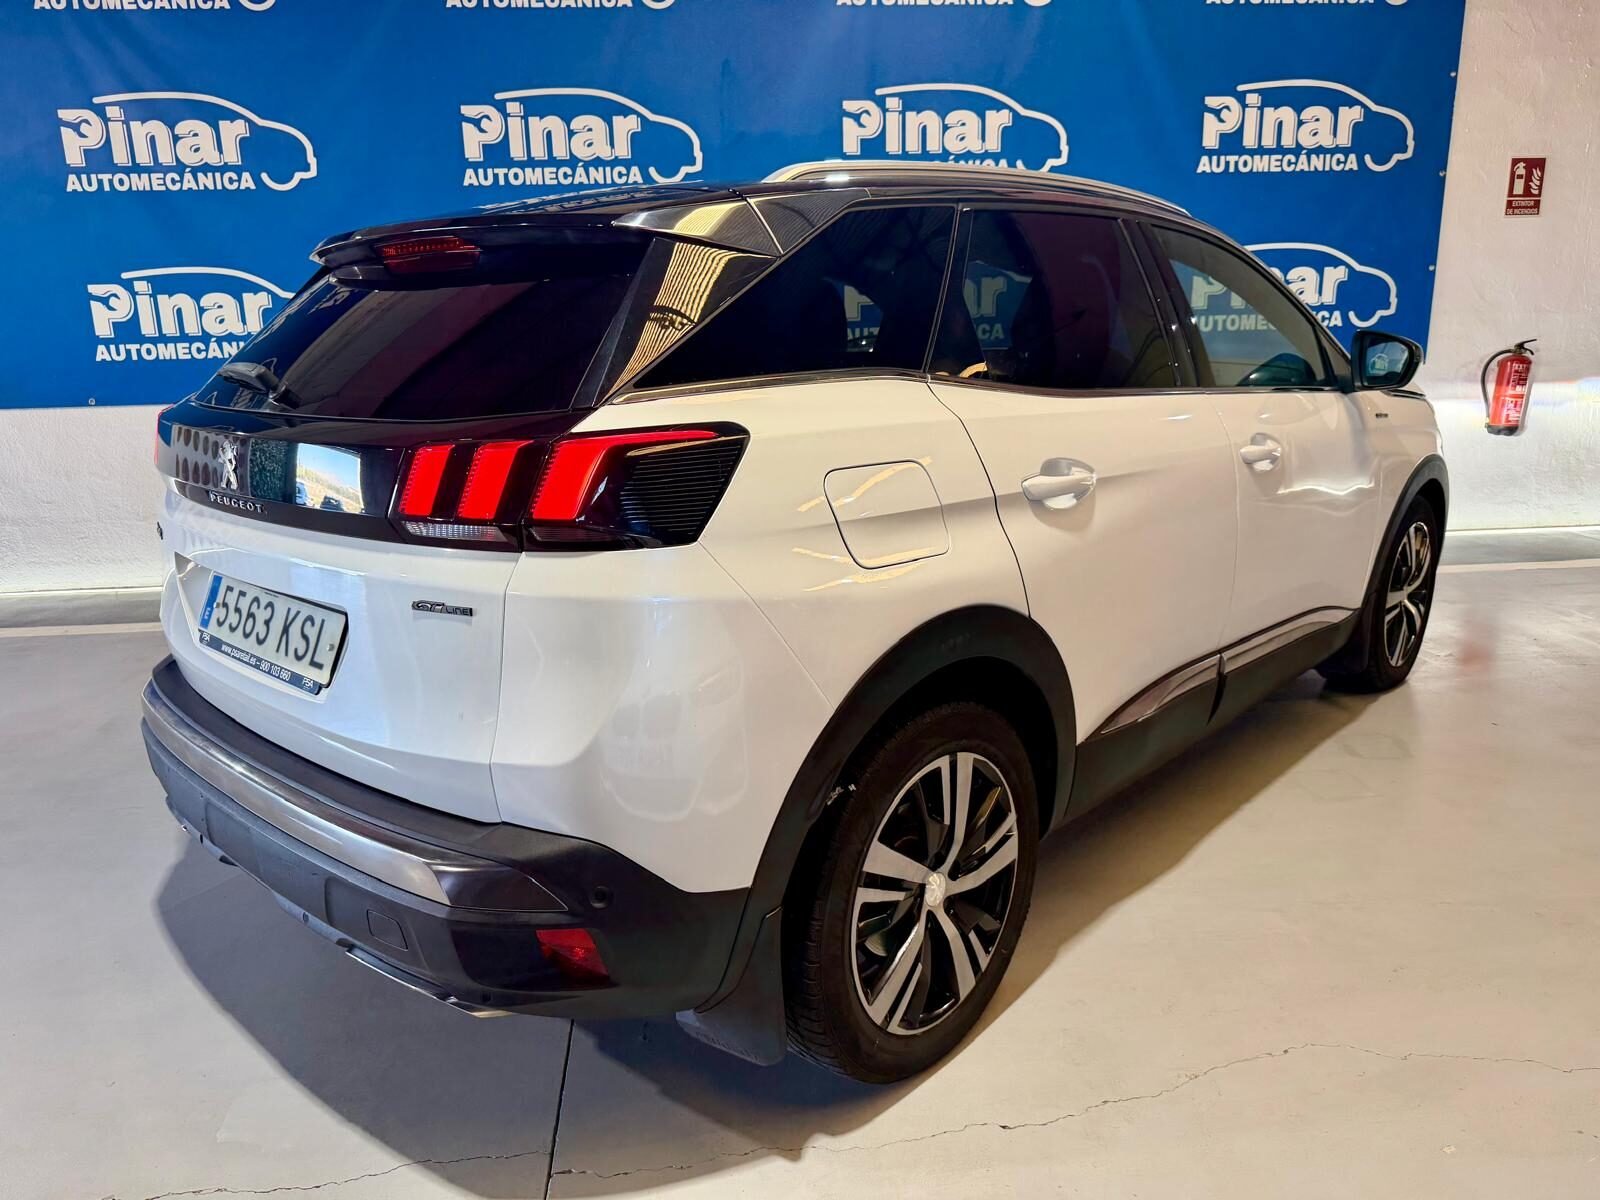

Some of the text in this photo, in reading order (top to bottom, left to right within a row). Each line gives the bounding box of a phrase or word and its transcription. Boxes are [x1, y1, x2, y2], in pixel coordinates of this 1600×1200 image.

[57, 106, 249, 167] Pinar
[460, 102, 641, 161] Pinar
[842, 97, 1012, 155] Pinar
[1202, 93, 1364, 149] Pinar
[66, 168, 256, 192] AUTOMECÁNICA
[463, 163, 643, 186] AUTOMECÁNICA
[1196, 150, 1359, 173] AUTOMECÁNICA
[87, 280, 272, 338] Pinar
[96, 338, 244, 361] AUTOMECÁN
[208, 490, 264, 513] PEUGEOT
[216, 585, 326, 670] 5563 KSL
[260, 660, 271, 672] 900
